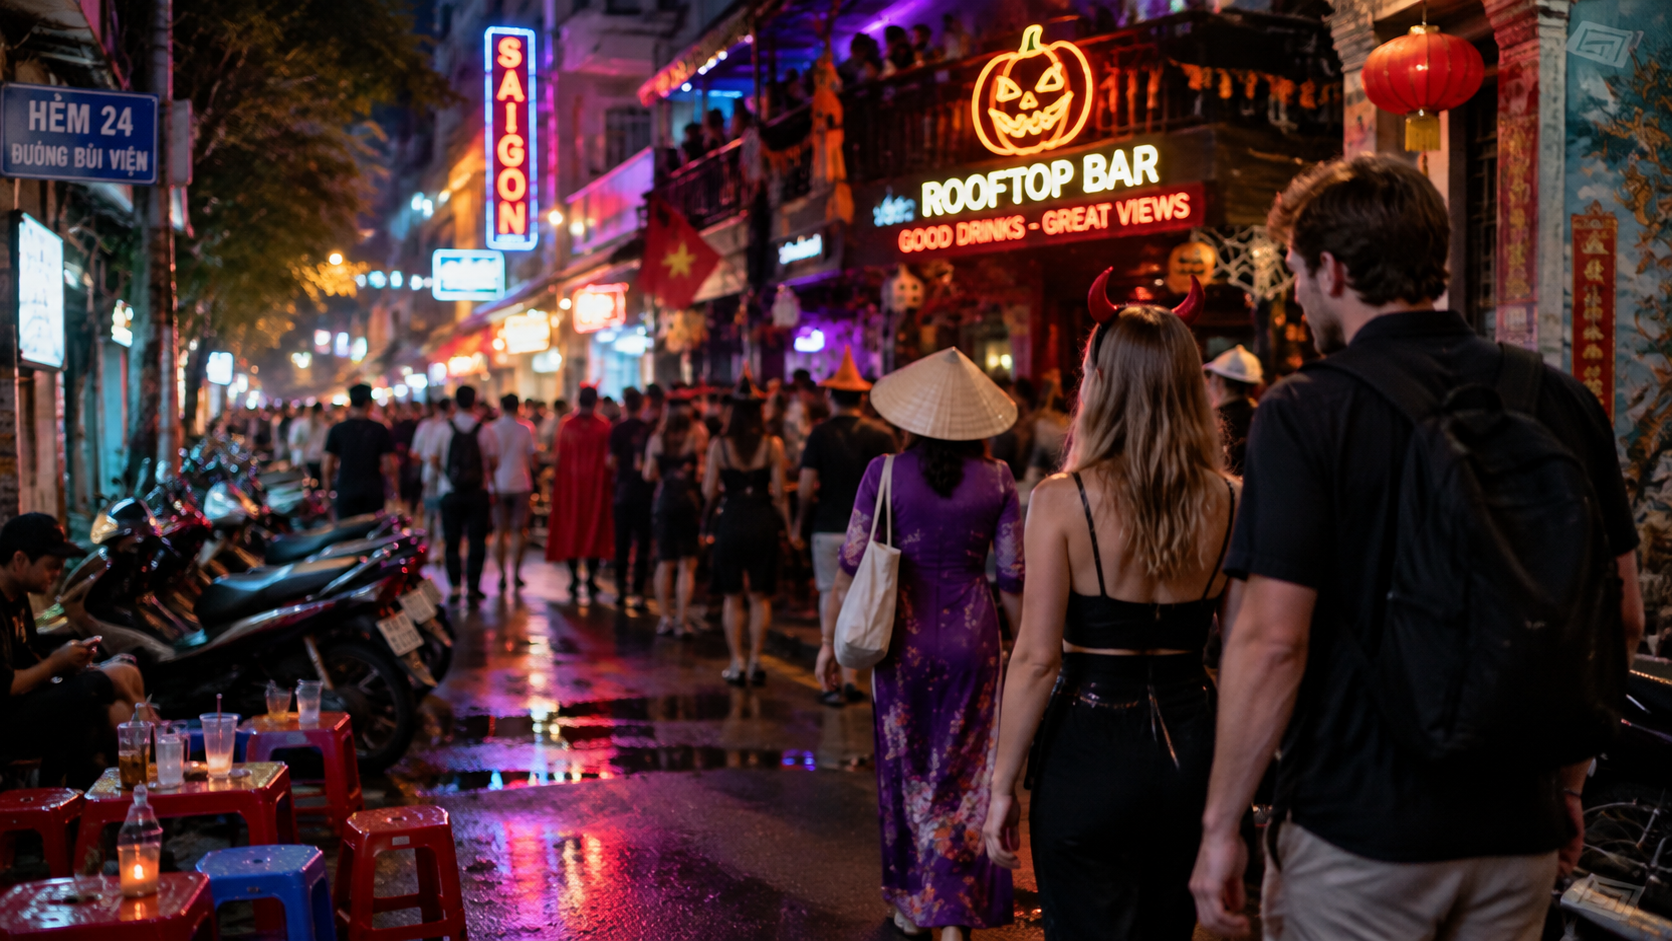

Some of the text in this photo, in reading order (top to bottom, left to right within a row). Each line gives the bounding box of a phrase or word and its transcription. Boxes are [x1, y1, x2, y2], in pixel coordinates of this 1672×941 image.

[100, 105, 133, 137] 24
[496, 36, 526, 235] SAIGON
[921, 159, 1074, 218] ROOFTOP
[1083, 144, 1159, 193] BAR
[898, 224, 953, 253] GOOD
[956, 215, 1026, 246] DRINKS
[1042, 202, 1112, 235] GREAT
[1116, 192, 1190, 226] VIEWS
